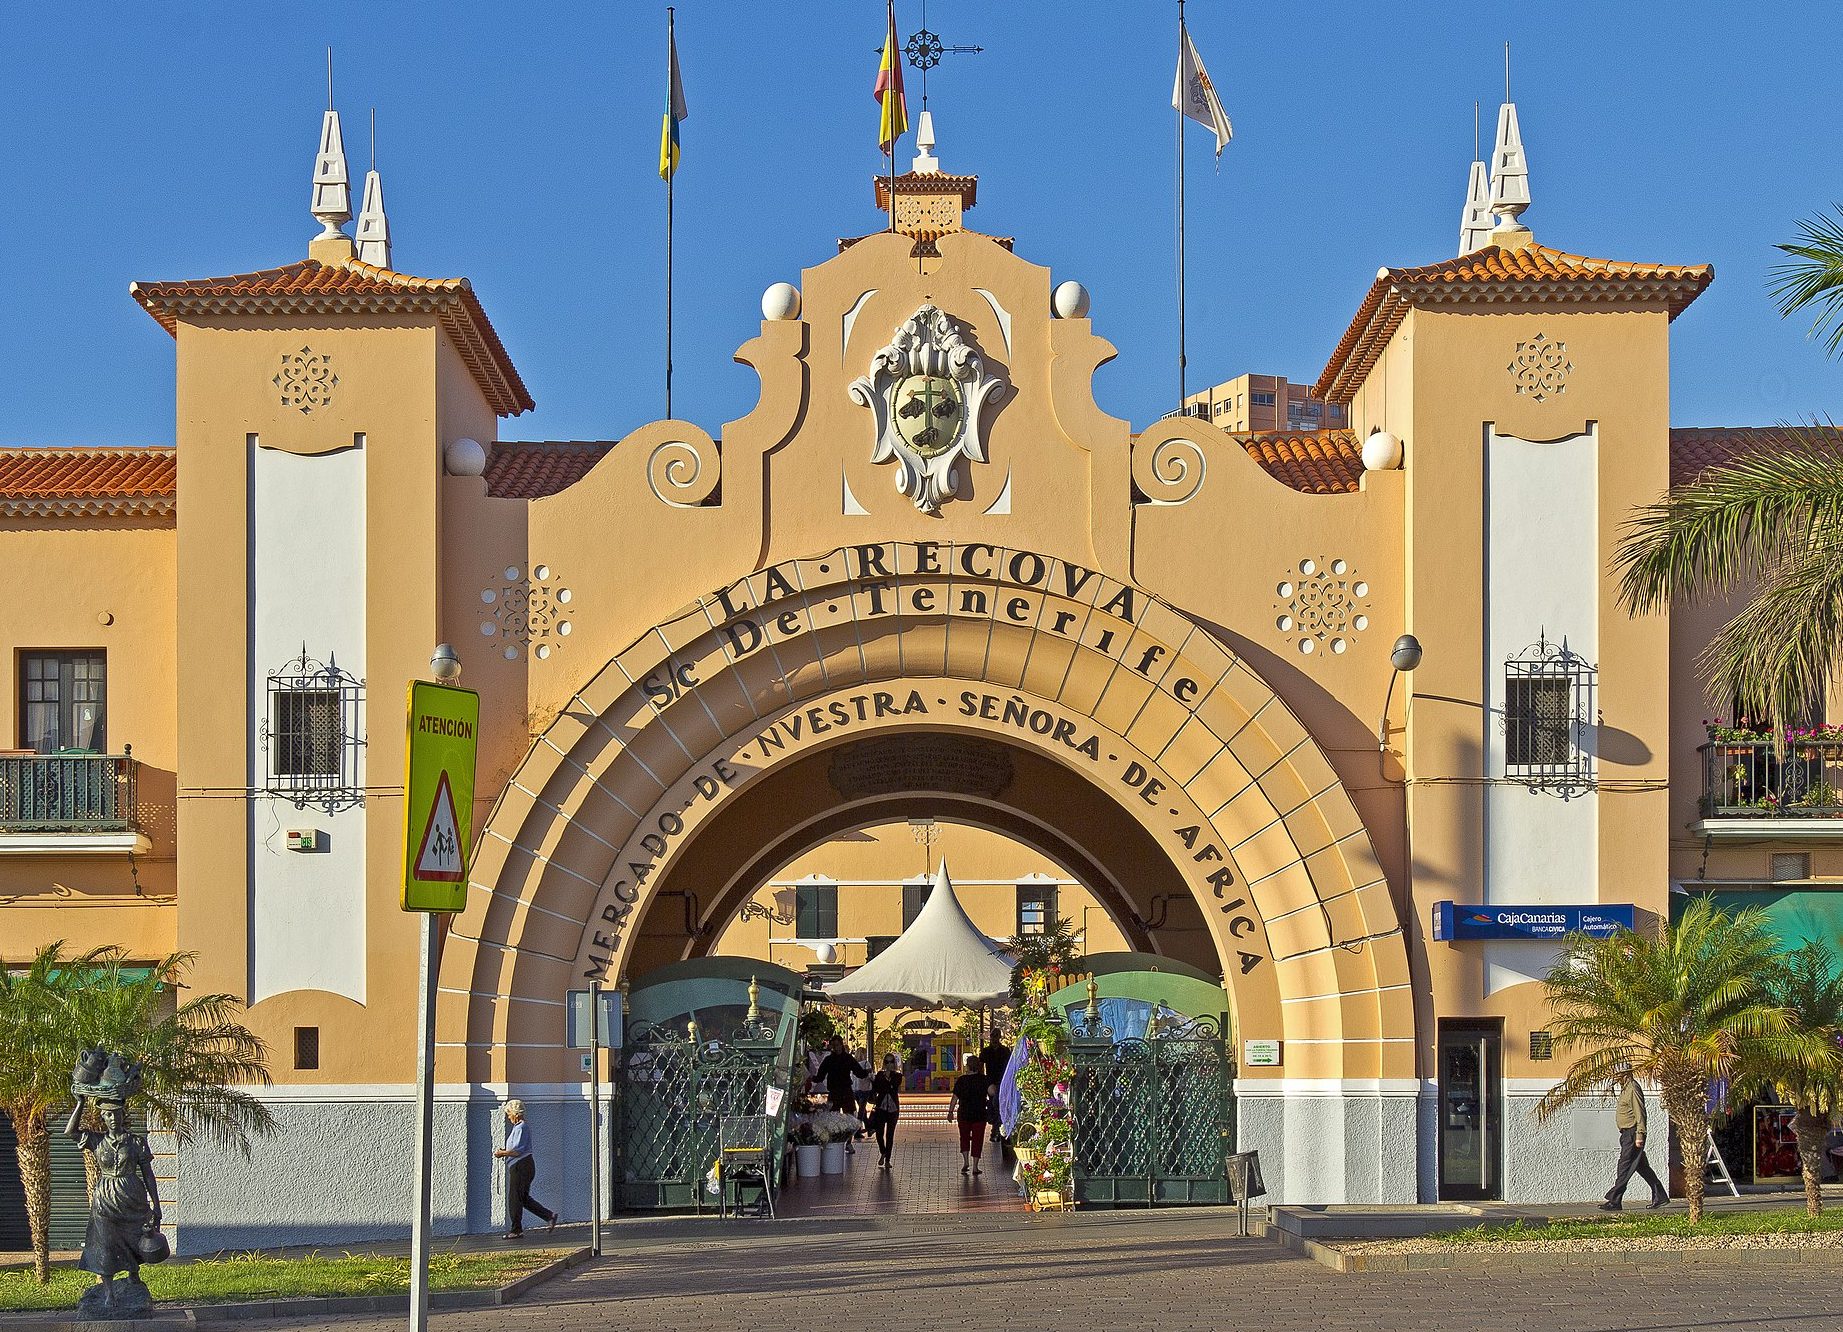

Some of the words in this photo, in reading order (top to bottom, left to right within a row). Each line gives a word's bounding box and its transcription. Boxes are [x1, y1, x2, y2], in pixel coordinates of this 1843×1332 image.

[712, 566, 798, 621] LA
[857, 540, 1136, 624] RECOVA
[722, 610, 802, 660] De
[861, 581, 1199, 703] Tenerife
[418, 714, 473, 740] ATENCIÓN
[583, 811, 685, 984] MERCADO
[692, 757, 738, 801] DE
[958, 691, 1101, 762] SEÑORA
[1120, 760, 1167, 806] DE
[1173, 824, 1265, 976] AFRICA
[1498, 912, 1566, 926] CajaCanarias
[1582, 915, 1602, 924] Cajero
